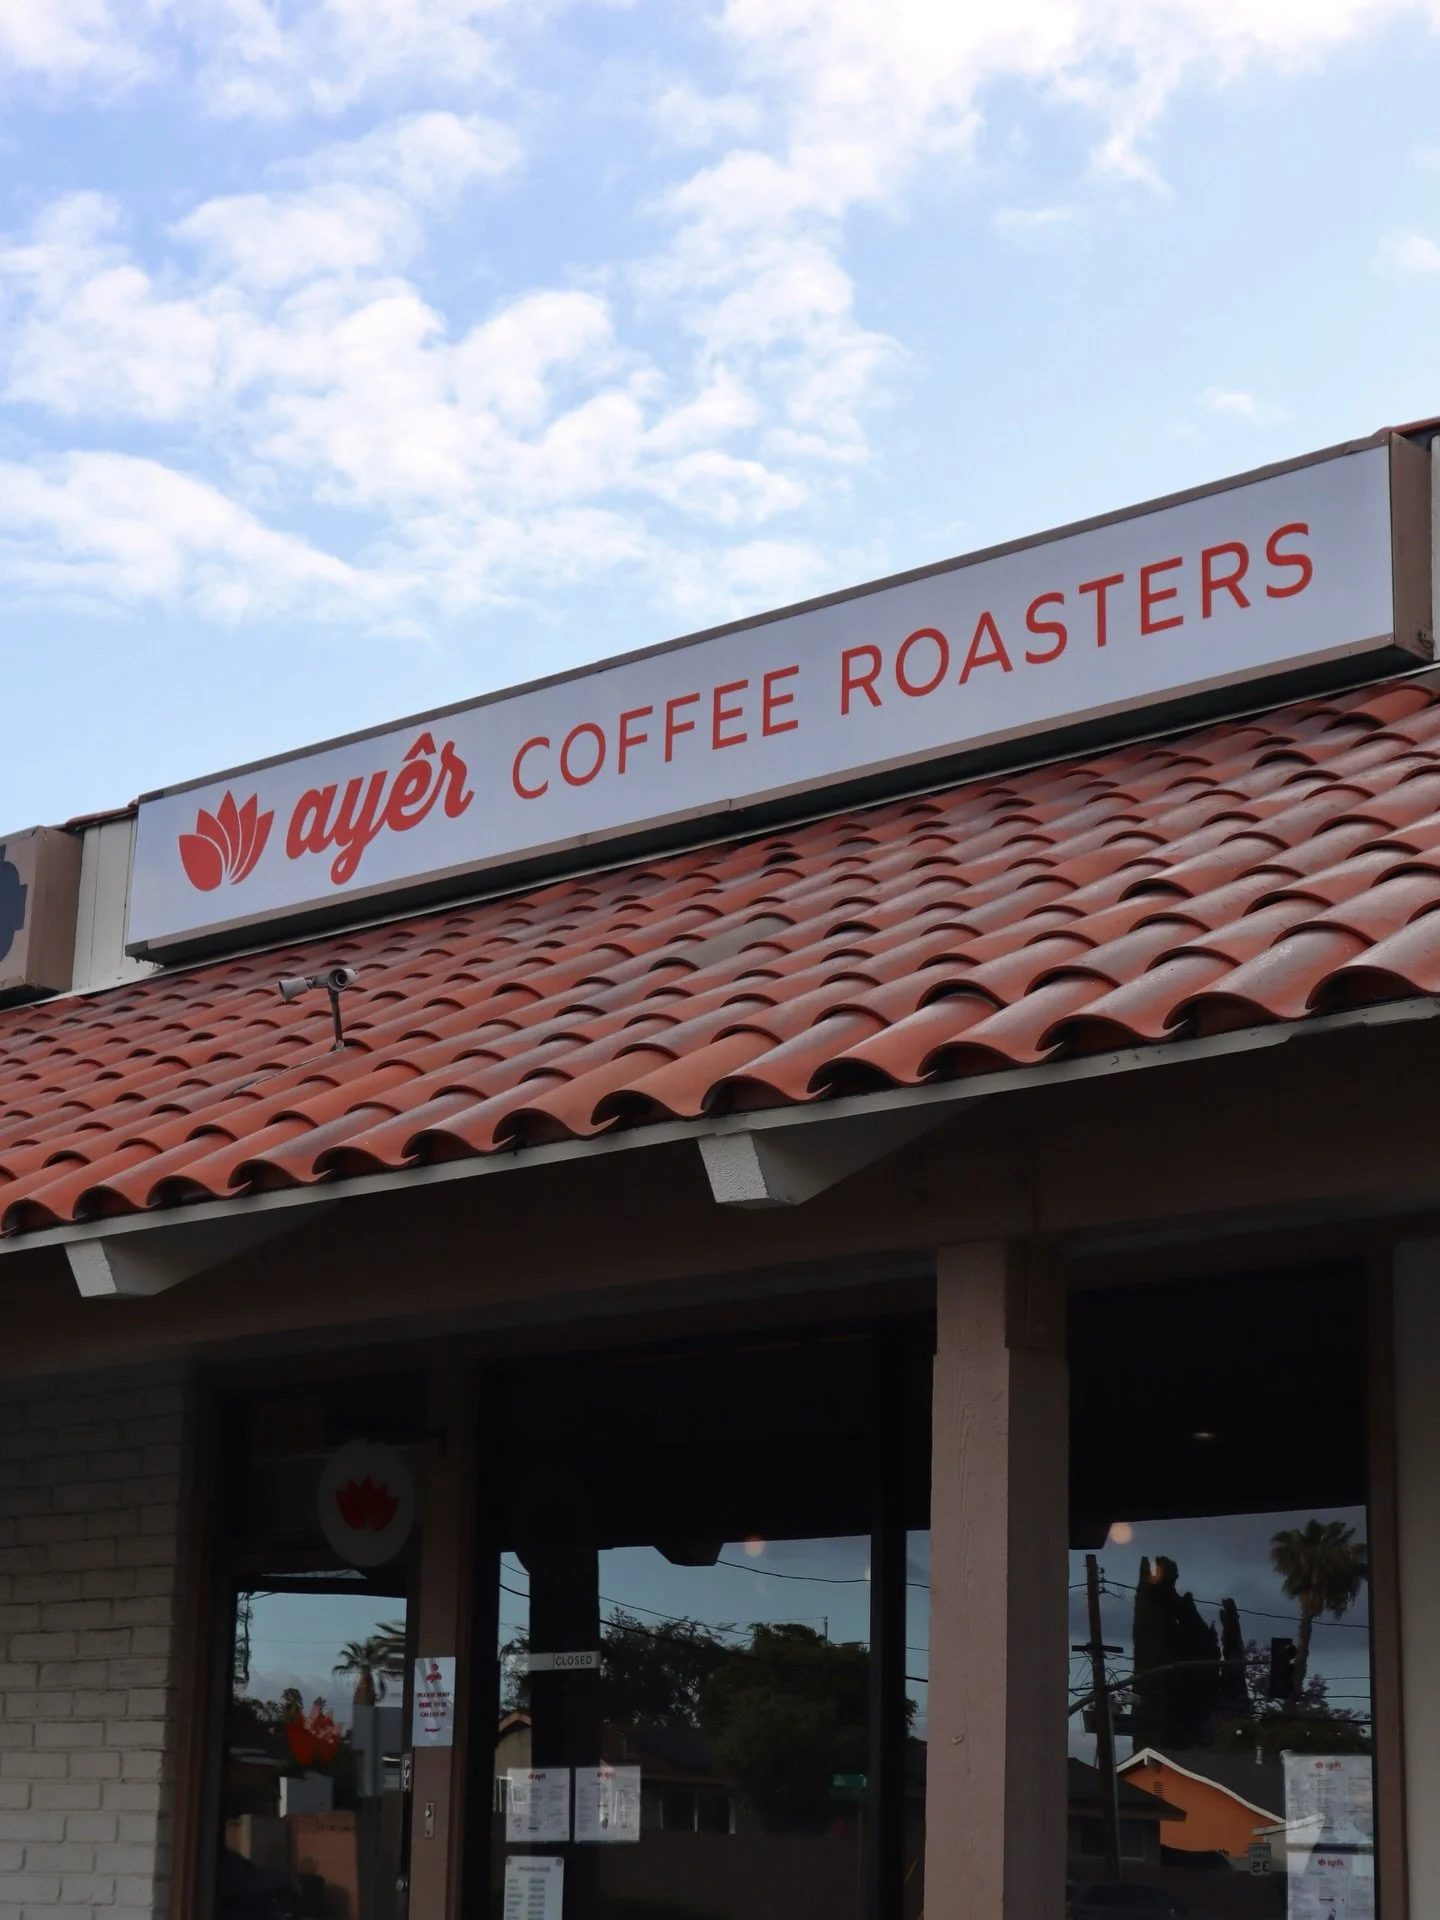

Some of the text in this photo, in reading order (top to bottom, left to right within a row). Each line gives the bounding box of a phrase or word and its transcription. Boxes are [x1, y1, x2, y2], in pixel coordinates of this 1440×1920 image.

[286, 522, 1313, 885] ayêr COFFEE ROASTERS
[555, 1655, 593, 1666] CLOSED
